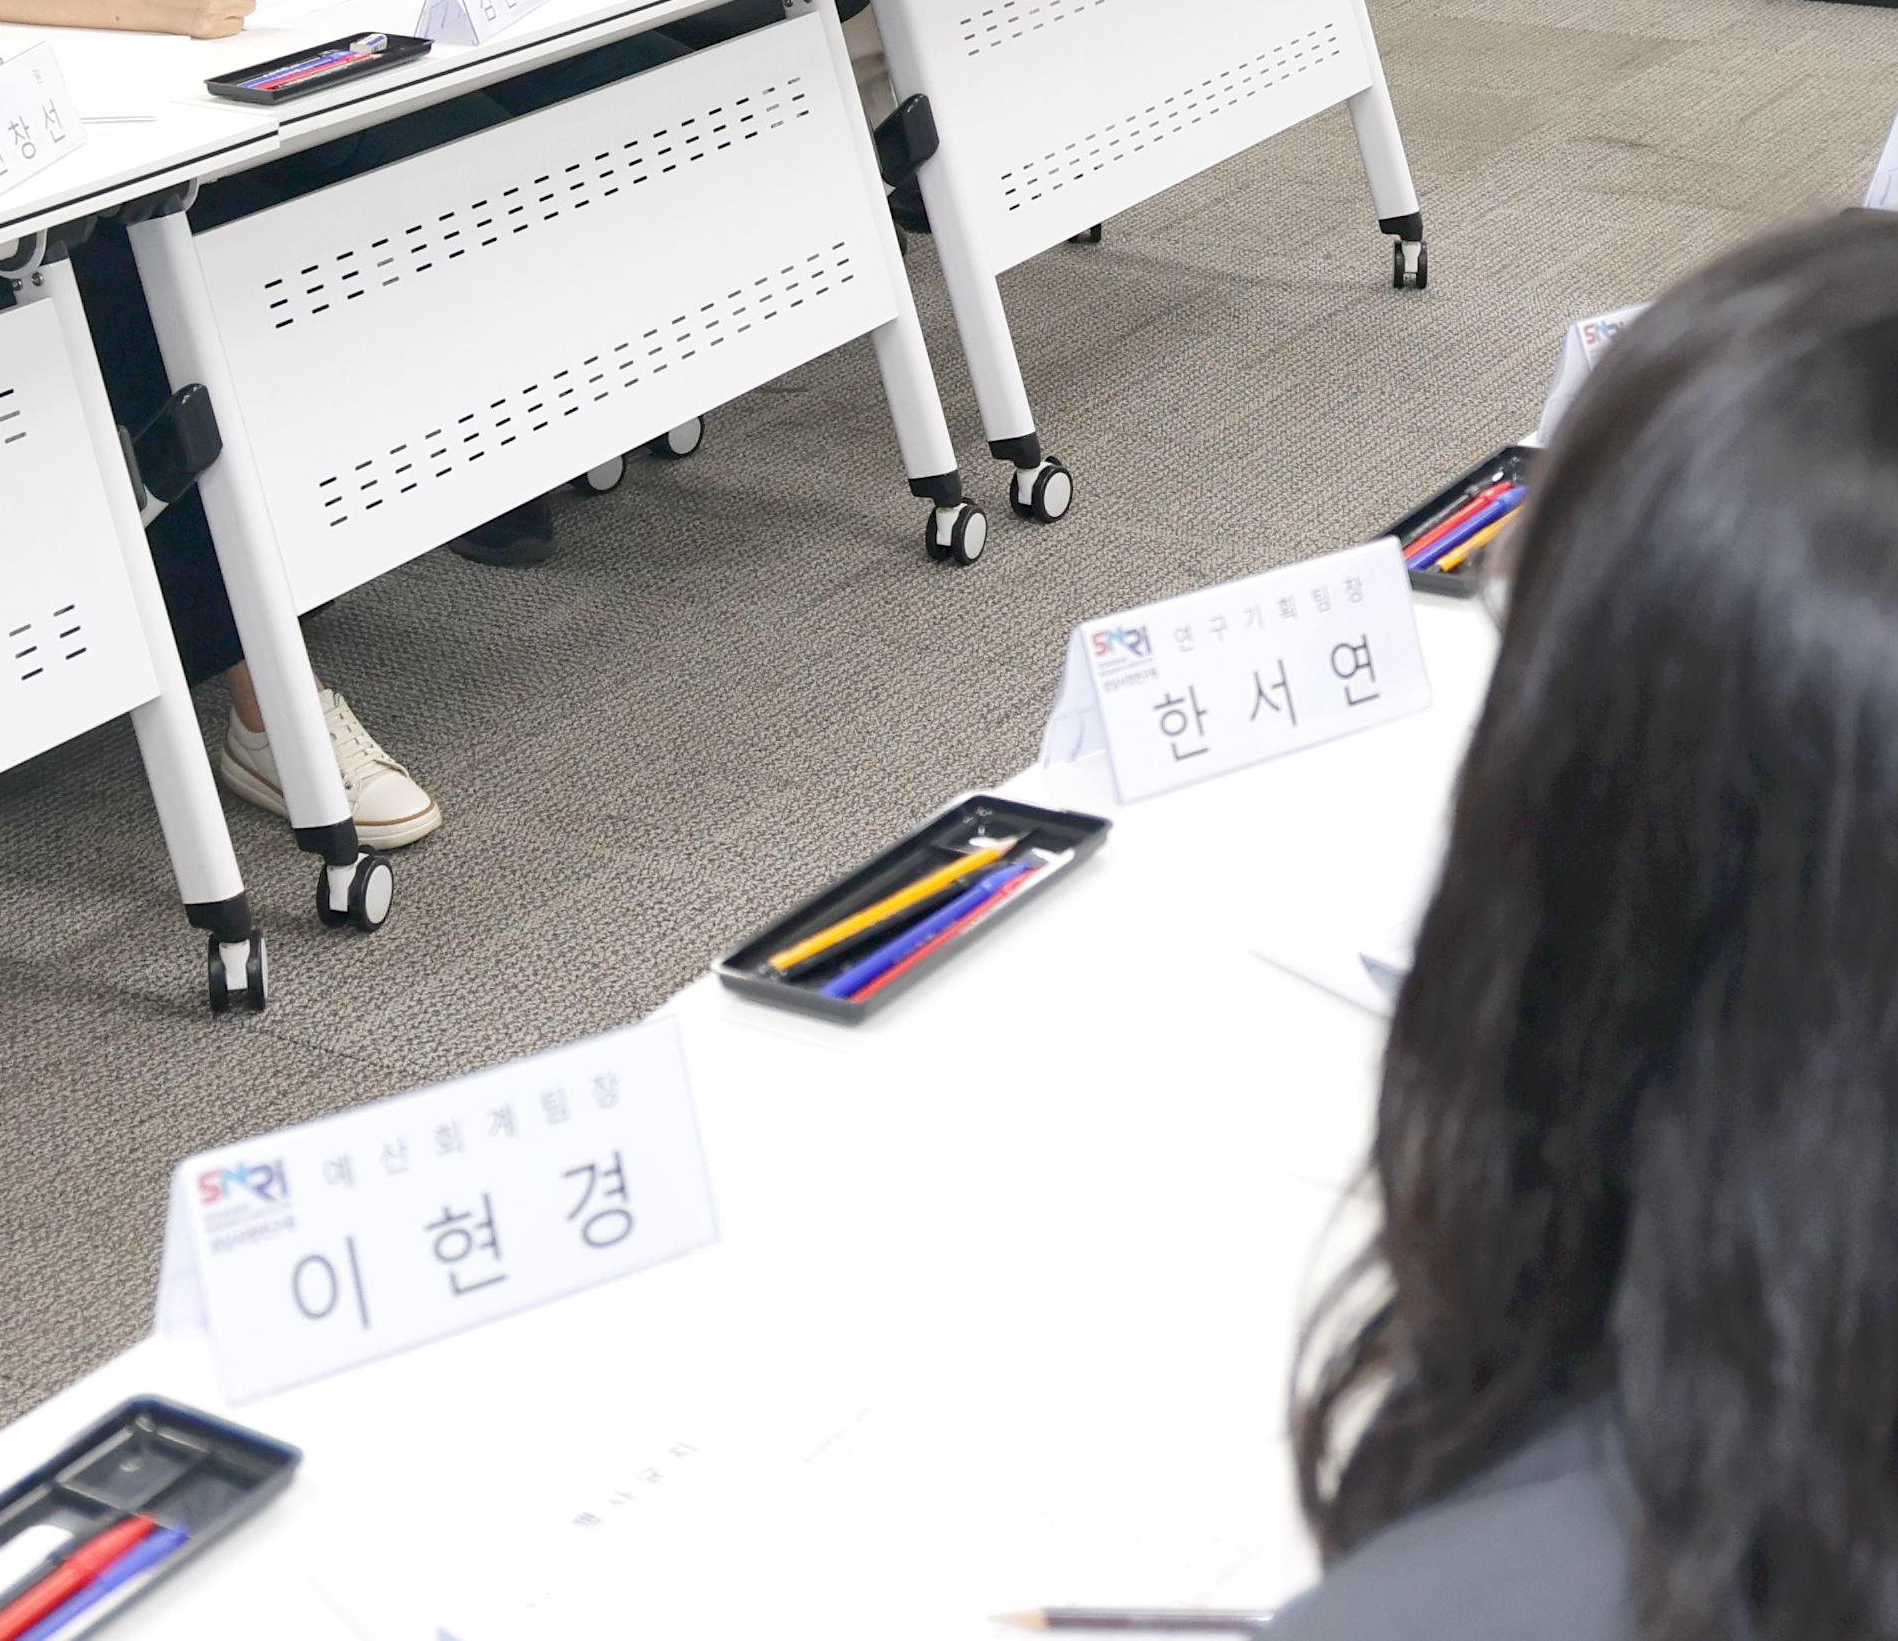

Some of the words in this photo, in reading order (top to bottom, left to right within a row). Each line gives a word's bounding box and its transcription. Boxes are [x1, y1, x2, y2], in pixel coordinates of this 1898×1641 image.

[1173, 576, 1363, 652] 연구기획팀장
[1153, 634, 1379, 761] 한서연
[323, 1071, 619, 1188] 예산회계팀장
[292, 1151, 633, 1328] 이현경
